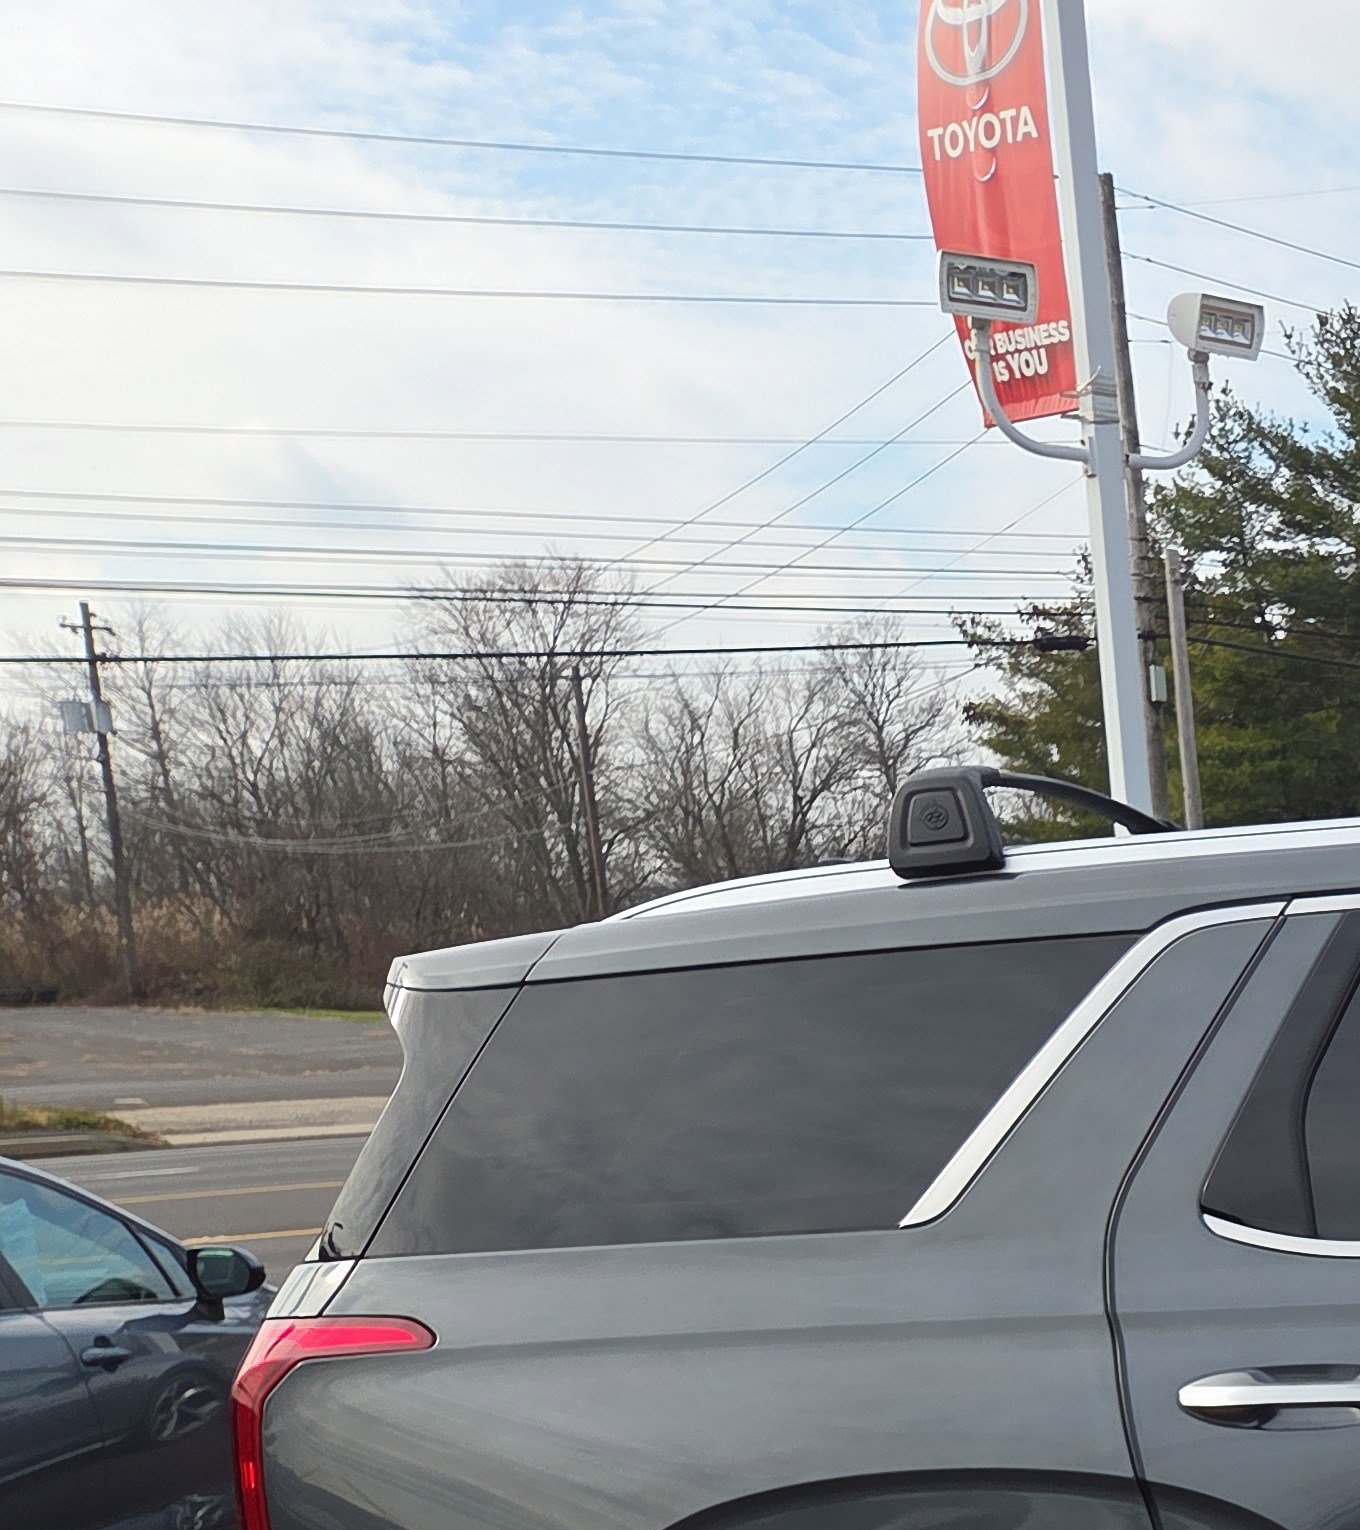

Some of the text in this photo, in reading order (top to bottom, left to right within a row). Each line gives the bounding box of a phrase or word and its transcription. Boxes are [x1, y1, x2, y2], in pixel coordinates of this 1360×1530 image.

[927, 105, 1039, 161] TOYOTA
[994, 320, 1070, 354] BUSINESS
[1005, 347, 1048, 378] YOU
